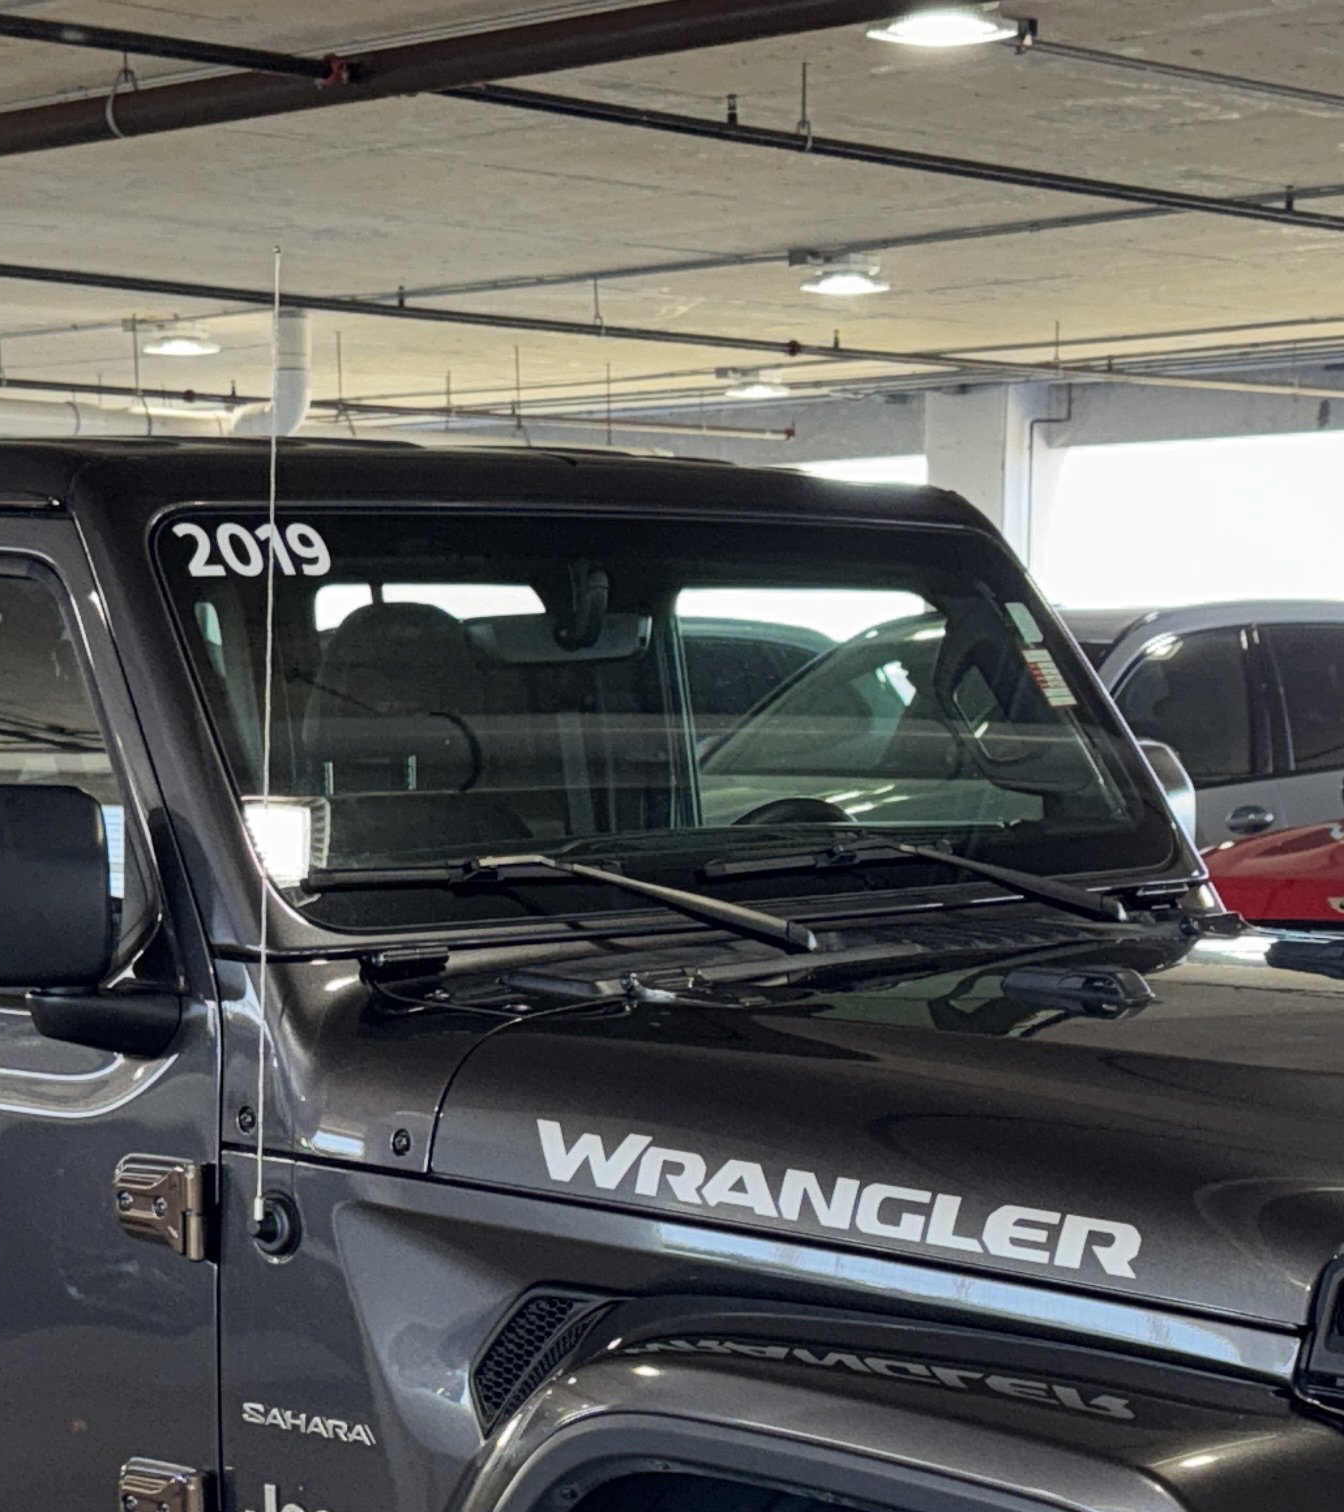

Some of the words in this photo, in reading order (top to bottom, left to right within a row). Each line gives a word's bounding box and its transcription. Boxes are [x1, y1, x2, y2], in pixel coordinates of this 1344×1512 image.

[171, 522, 331, 577] 2019
[536, 1118, 1143, 1279] WRANGLER
[242, 1402, 377, 1446] SAHARA
